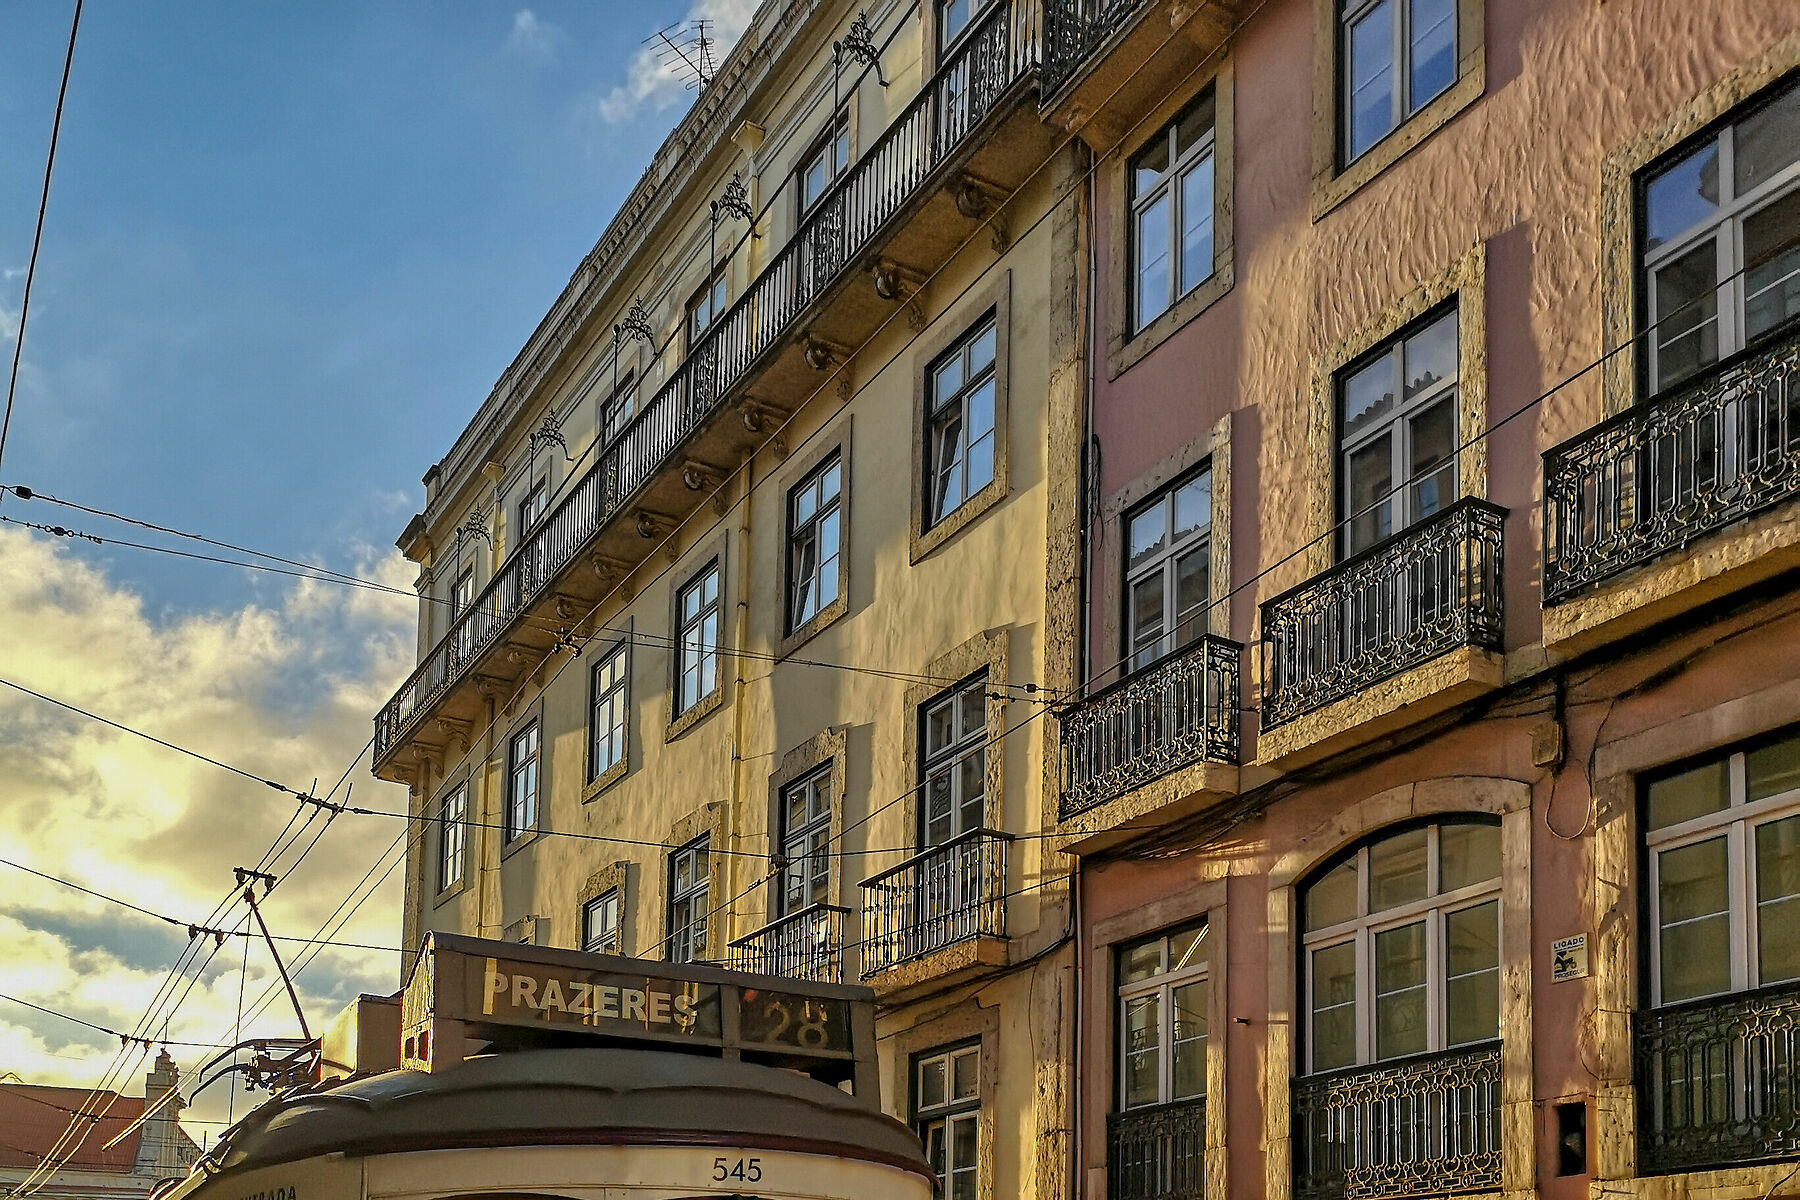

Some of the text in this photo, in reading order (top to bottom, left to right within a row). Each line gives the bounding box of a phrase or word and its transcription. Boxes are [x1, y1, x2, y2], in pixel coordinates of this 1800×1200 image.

[484, 972, 696, 1027] PRAZERES
[763, 1001, 829, 1048] 28
[712, 1157, 762, 1182] 545
